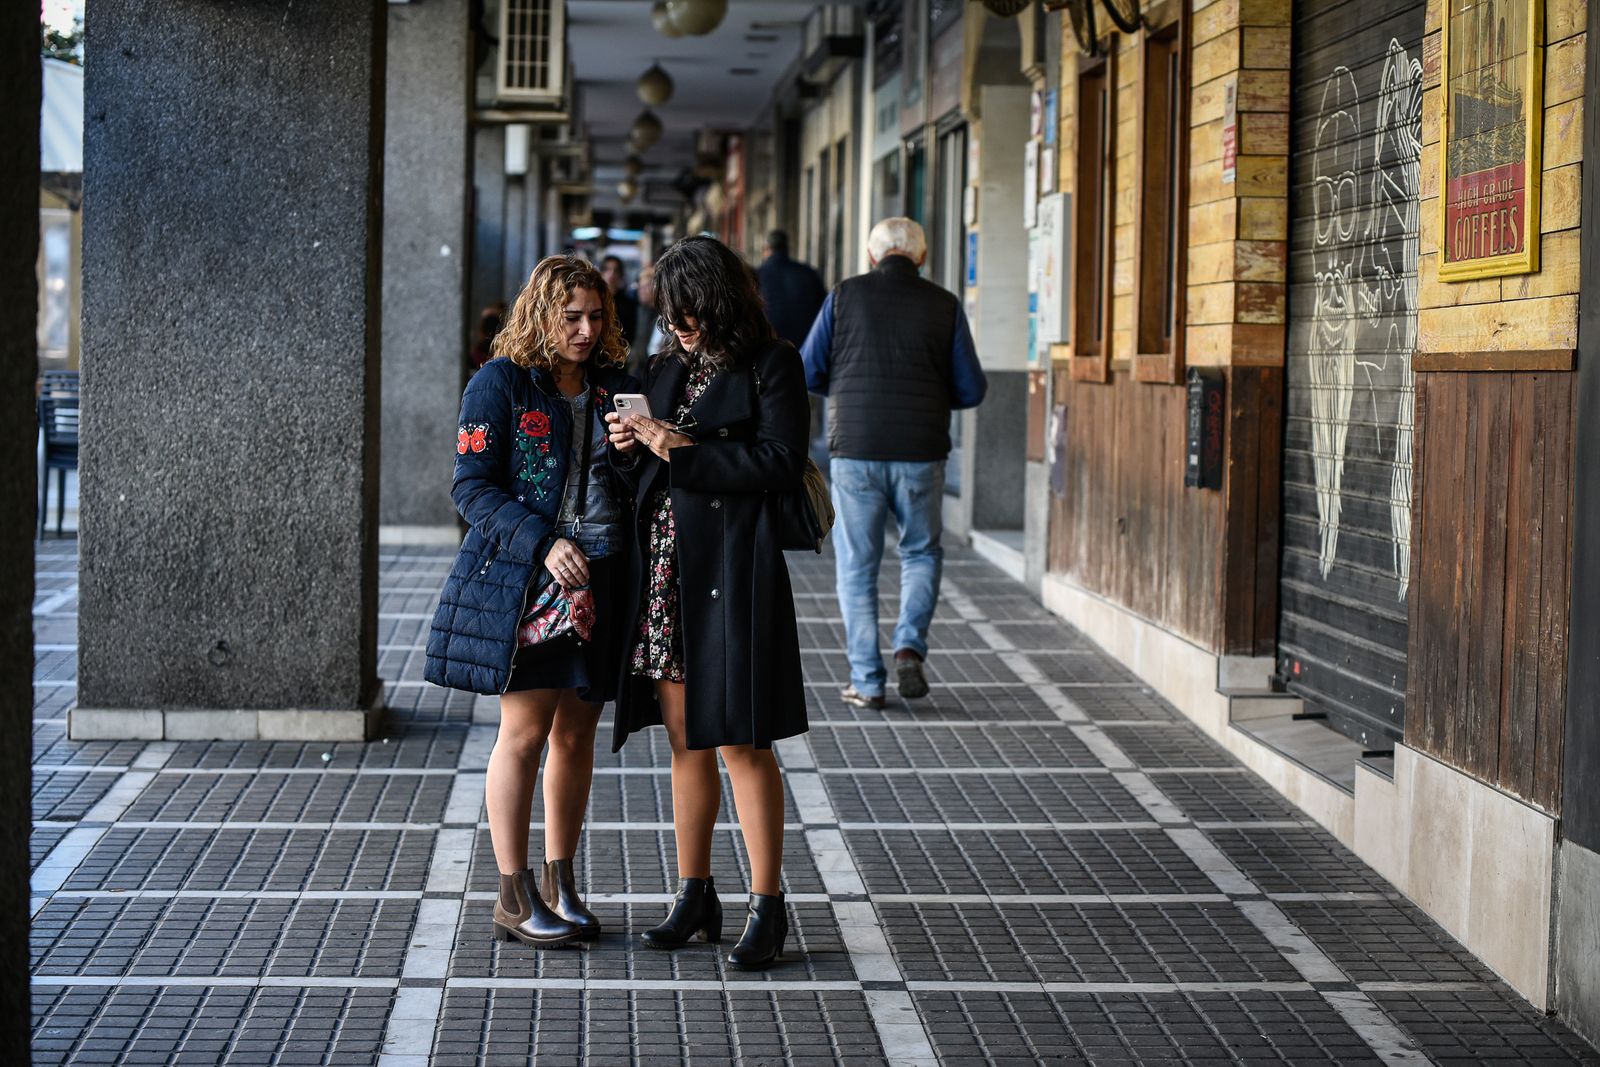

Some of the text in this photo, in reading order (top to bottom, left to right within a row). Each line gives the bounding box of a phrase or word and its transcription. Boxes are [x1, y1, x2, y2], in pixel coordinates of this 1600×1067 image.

[1457, 178, 1514, 209] HIGH GRADE
[1454, 206, 1519, 260] COFFEES
